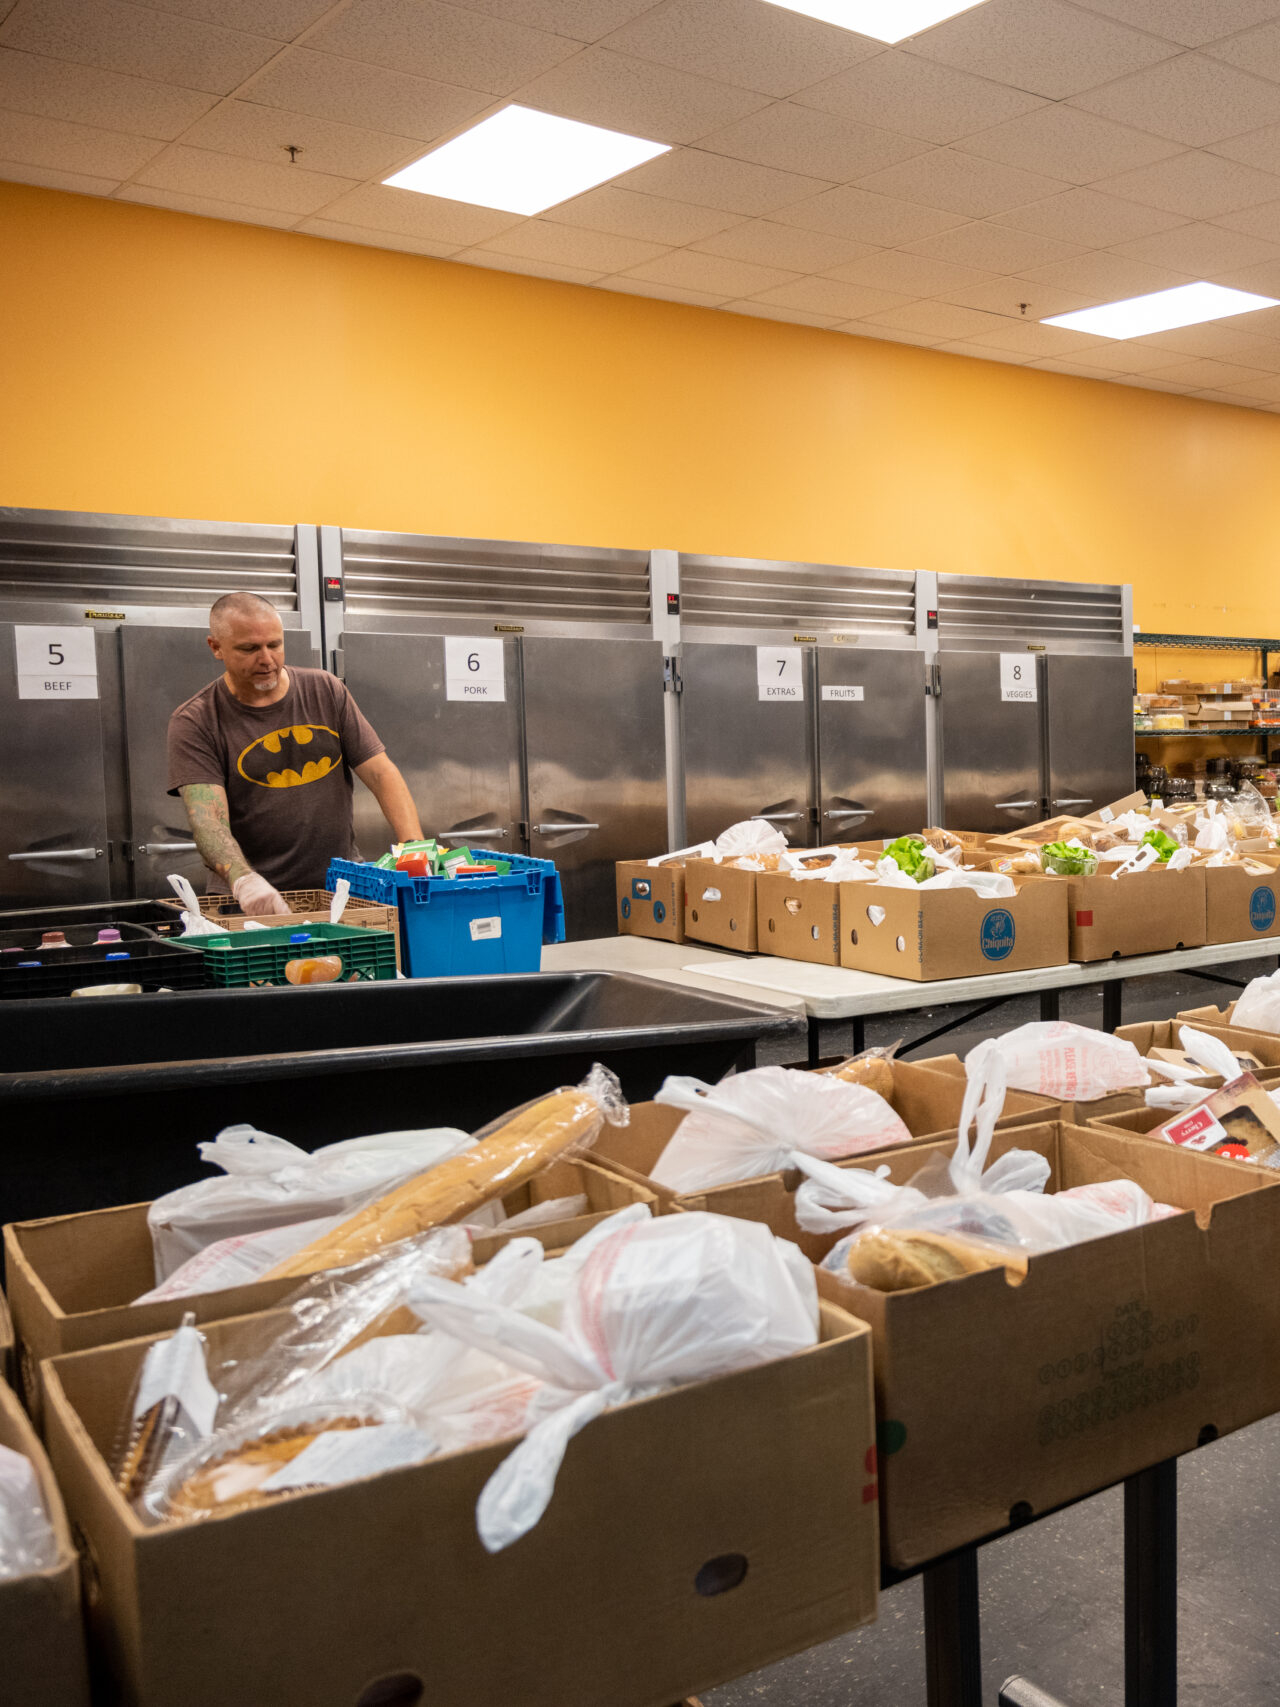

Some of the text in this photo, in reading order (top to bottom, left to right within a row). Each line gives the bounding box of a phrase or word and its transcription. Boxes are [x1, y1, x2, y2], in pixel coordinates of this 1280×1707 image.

[48, 643, 65, 666] 5
[467, 652, 480, 672] 6
[776, 660, 786, 677] 7
[1013, 665, 1022, 681] 8
[44, 681, 72, 691] BEEF
[464, 686, 488, 695] PORK
[767, 687, 796, 696] EXTRAS
[830, 689, 856, 698] FRUITS
[1006, 690, 1033, 699] VEGGIES
[1181, 1121, 1204, 1137] Cherry
